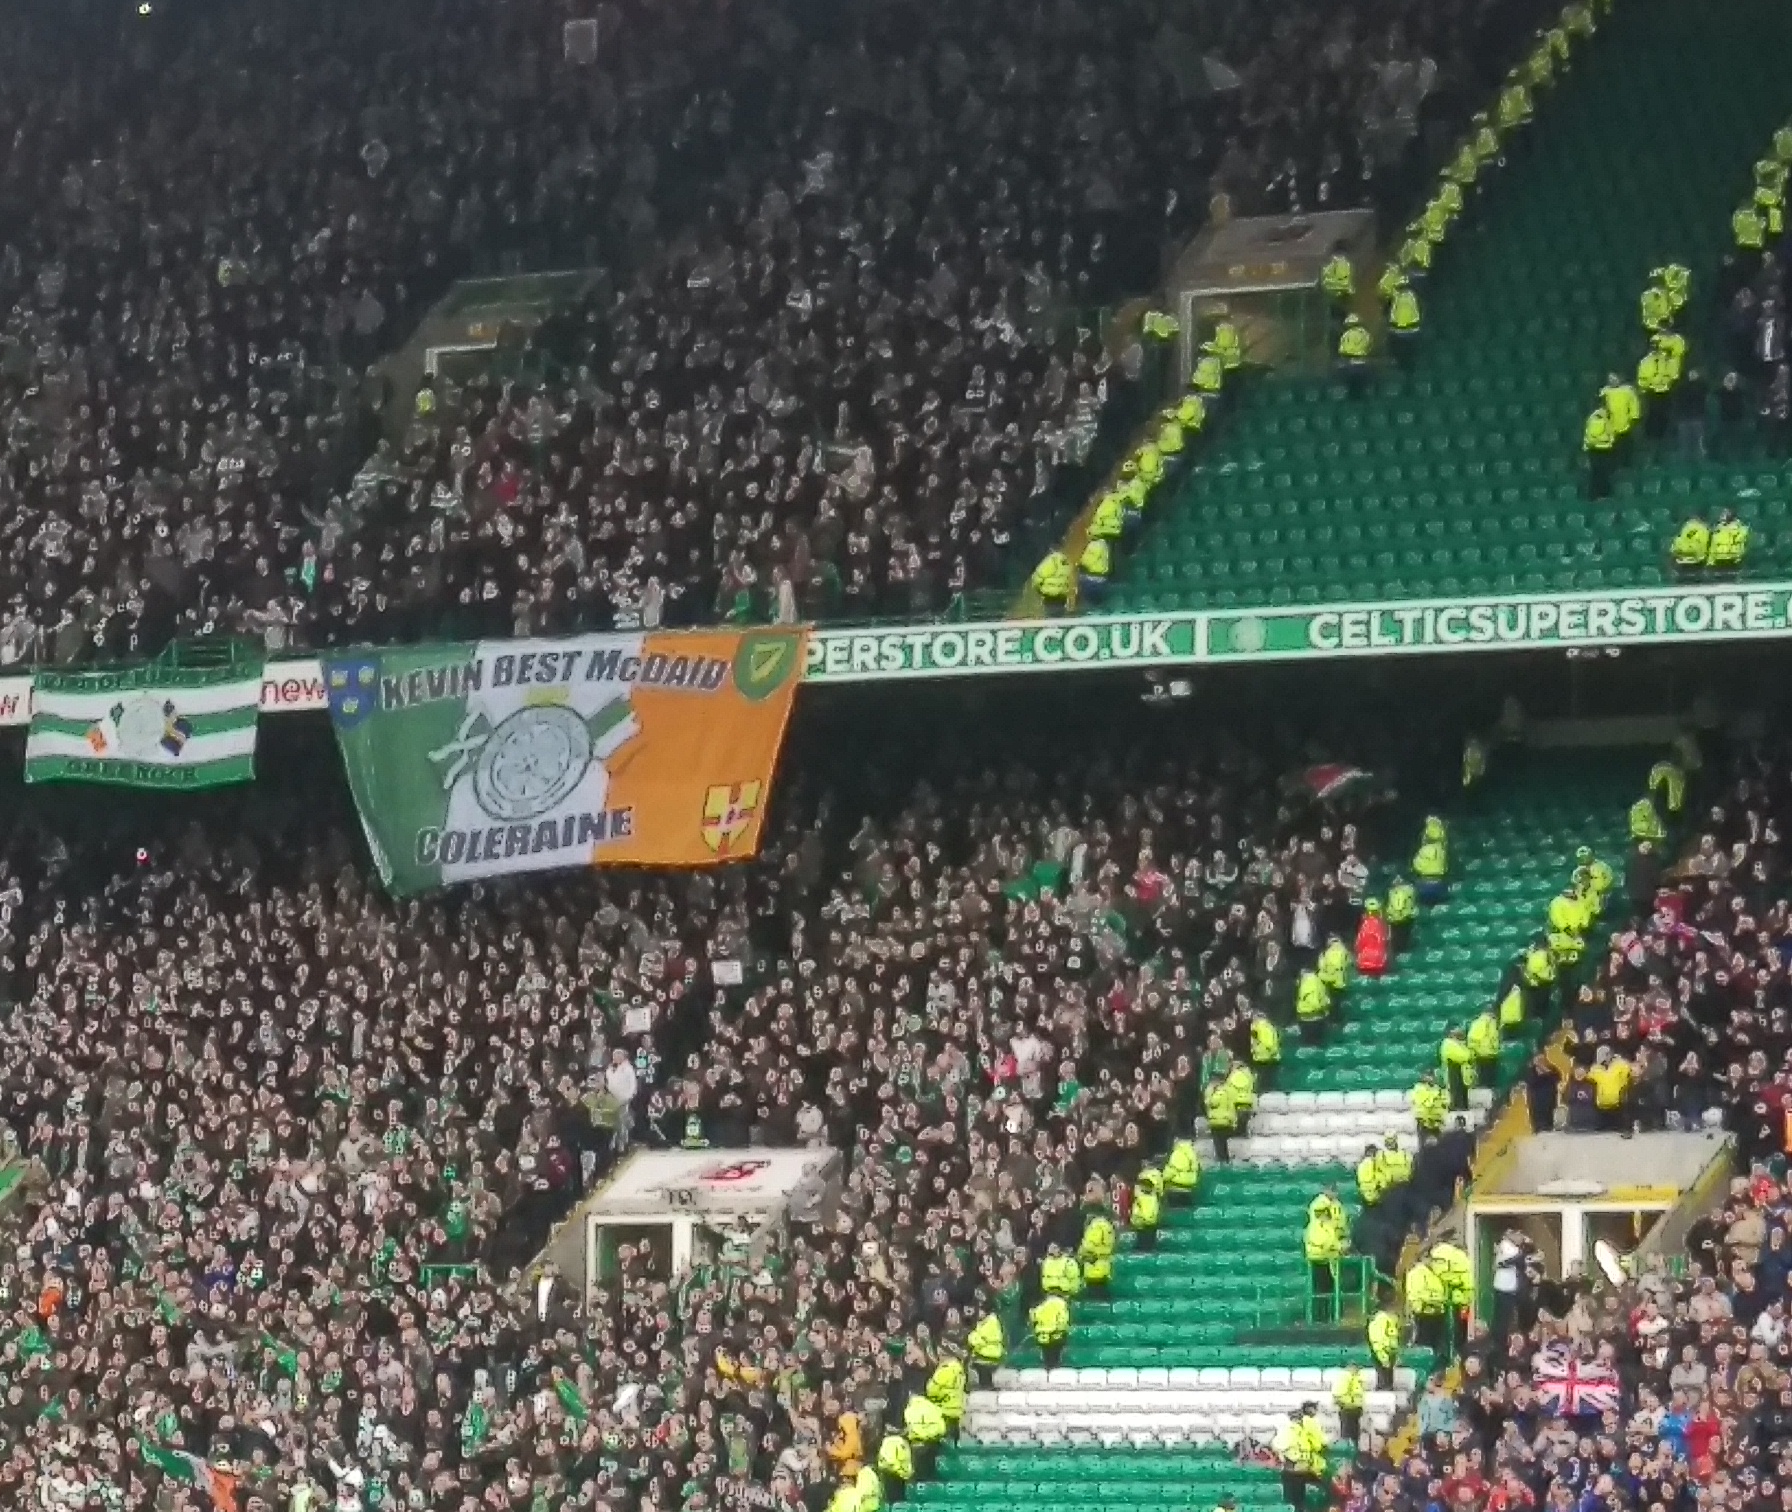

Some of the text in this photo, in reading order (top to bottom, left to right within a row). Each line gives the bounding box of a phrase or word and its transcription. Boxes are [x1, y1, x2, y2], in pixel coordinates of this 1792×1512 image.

[1308, 593, 1792, 650] CELTICSUPERSTORE.
[260, 677, 325, 704] new
[382, 648, 734, 708] KEVIN BEST McDAID
[416, 806, 633, 866] COLERAINE
